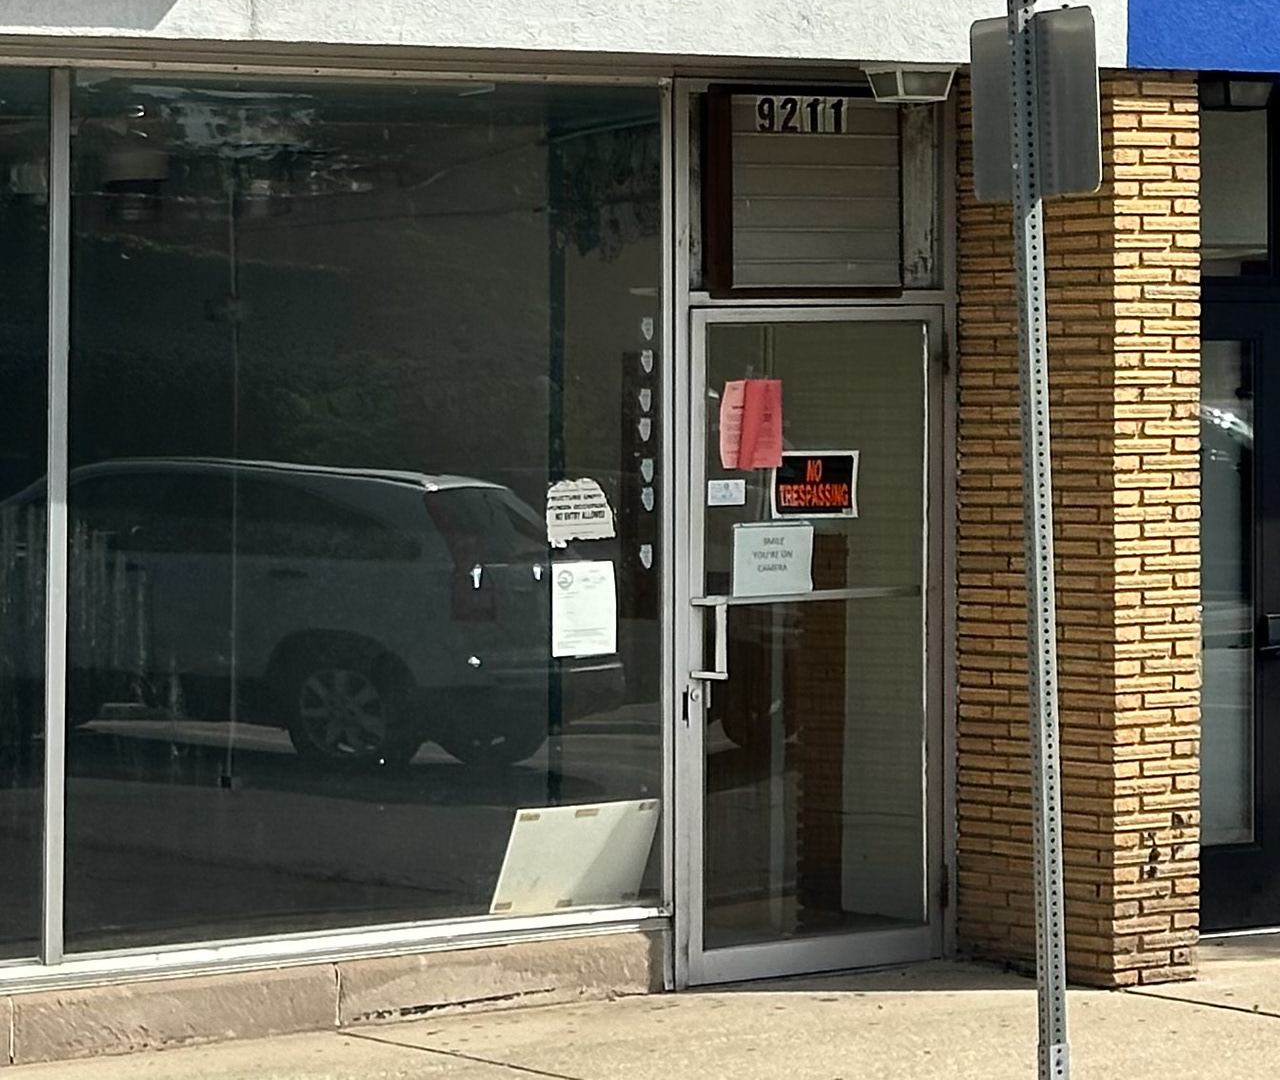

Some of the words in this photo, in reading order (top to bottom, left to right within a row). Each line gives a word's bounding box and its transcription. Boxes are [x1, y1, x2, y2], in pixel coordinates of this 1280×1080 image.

[757, 97, 844, 133] 9211
[806, 460, 822, 482] NO
[778, 484, 849, 507] TRESPASSING
